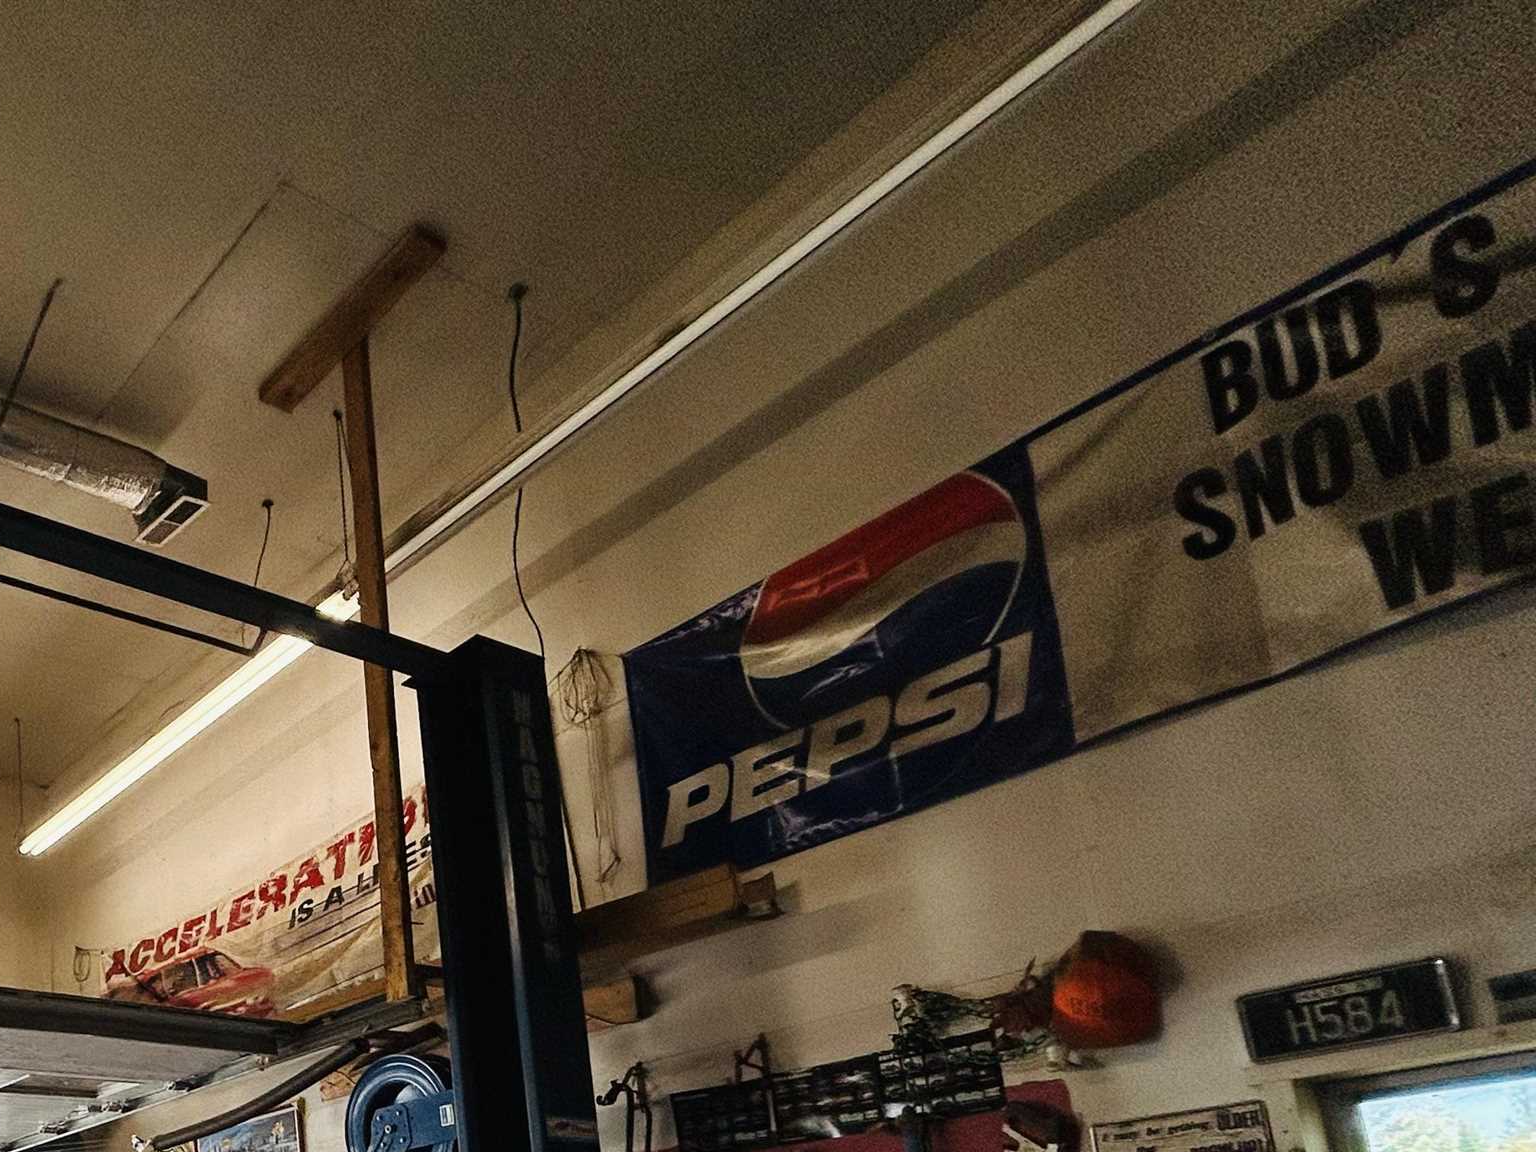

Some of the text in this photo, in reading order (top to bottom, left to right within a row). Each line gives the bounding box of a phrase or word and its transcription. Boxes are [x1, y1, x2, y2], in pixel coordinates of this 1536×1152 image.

[660, 629, 1037, 849] PEPSI
[288, 899, 315, 930] IS
[323, 886, 346, 911] A
[1285, 990, 1407, 1045] H584
